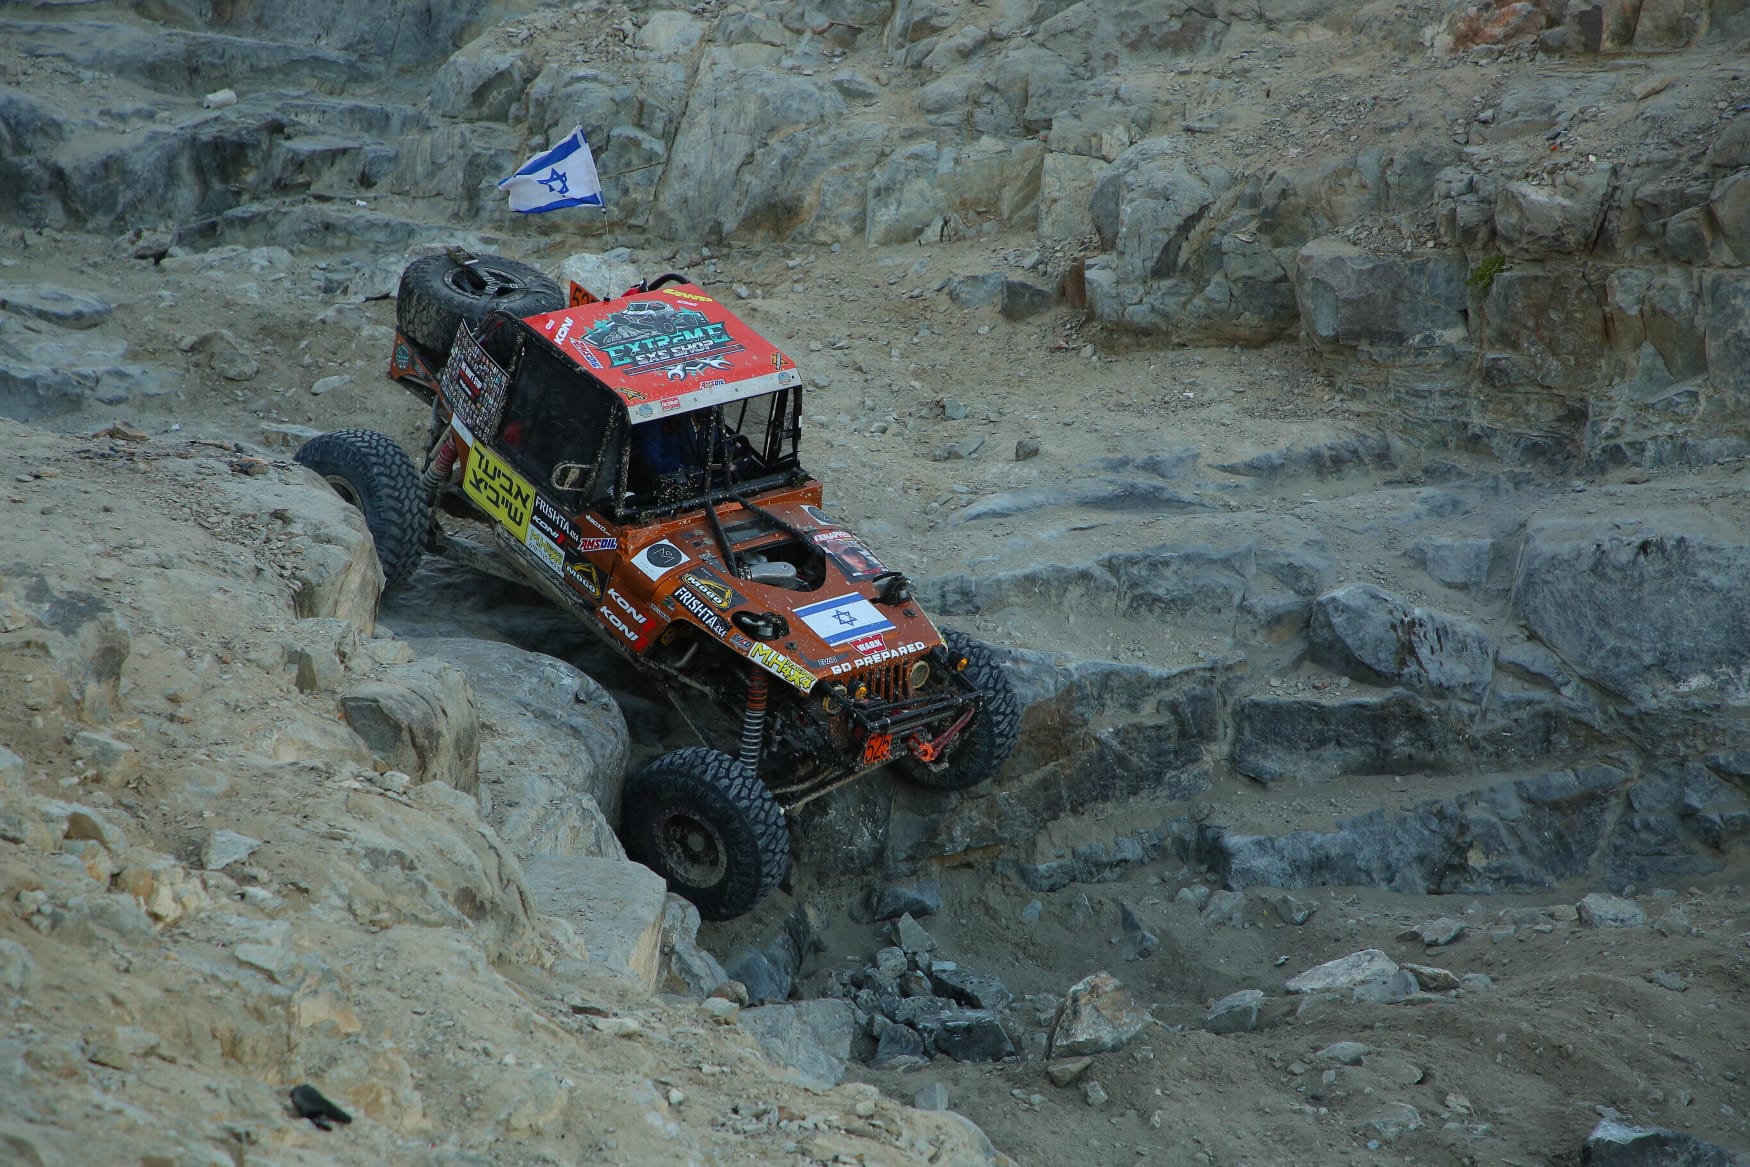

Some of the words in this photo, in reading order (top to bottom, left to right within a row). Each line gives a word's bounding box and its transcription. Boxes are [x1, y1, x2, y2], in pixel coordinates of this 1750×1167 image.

[554, 316, 574, 345] KONI
[605, 322, 733, 366] EXTREME
[672, 340, 714, 357] SHOP
[532, 515, 560, 538] KONI
[535, 496, 571, 534] FRISHTA
[580, 538, 617, 550] AMSOIL
[608, 587, 648, 625] KONI
[674, 586, 719, 631] FRISHTA
[713, 623, 727, 640] 4X4
[599, 605, 640, 641] KONI
[854, 641, 926, 669] PREPARED
[856, 639, 883, 652] WARN
[751, 642, 789, 674] M.H
[782, 667, 812, 688] 4X4
